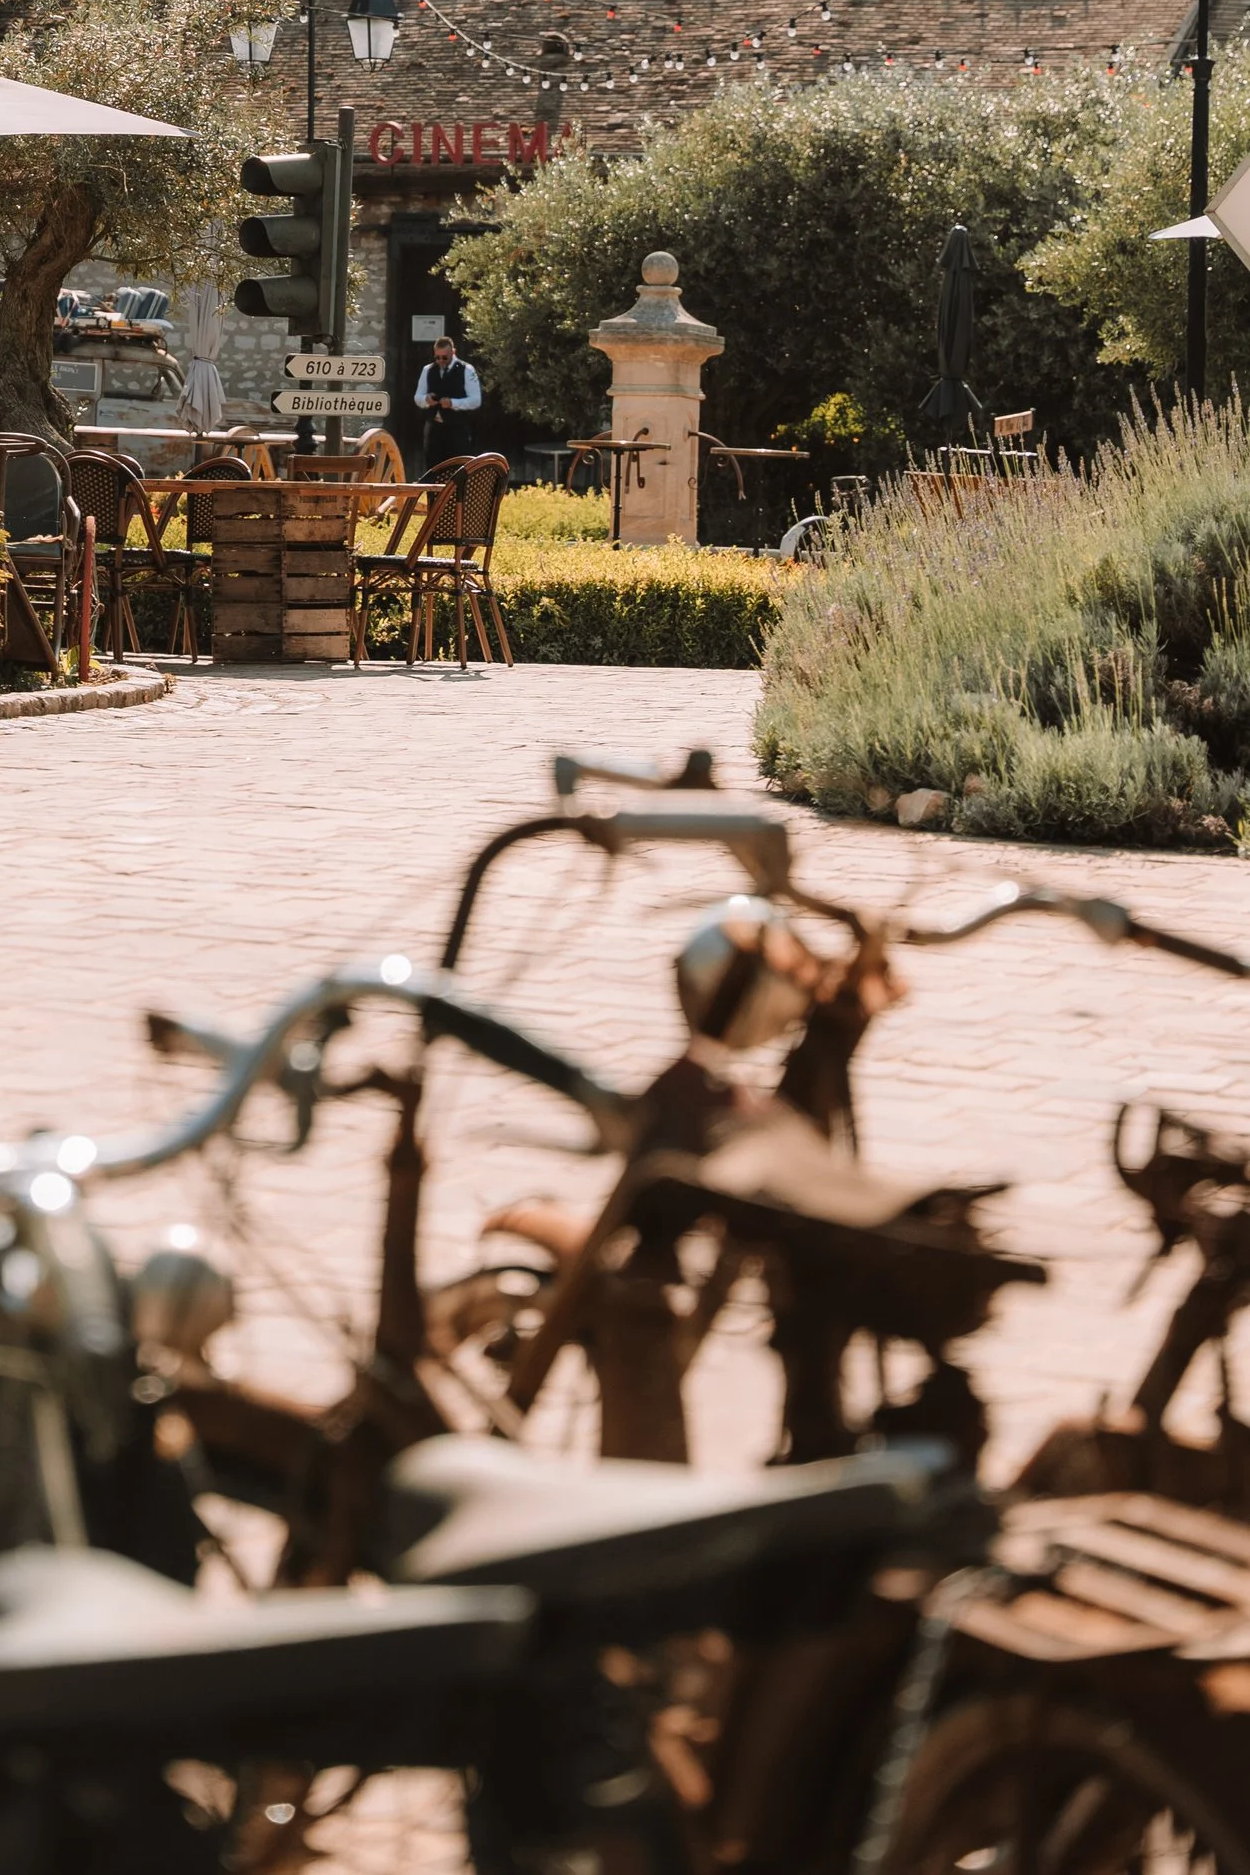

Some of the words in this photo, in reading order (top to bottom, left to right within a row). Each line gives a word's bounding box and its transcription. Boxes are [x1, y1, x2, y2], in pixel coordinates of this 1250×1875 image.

[305, 360, 332, 376] 610
[336, 362, 346, 376] à
[350, 362, 377, 377] 723
[291, 396, 383, 414] Bibliothèque
